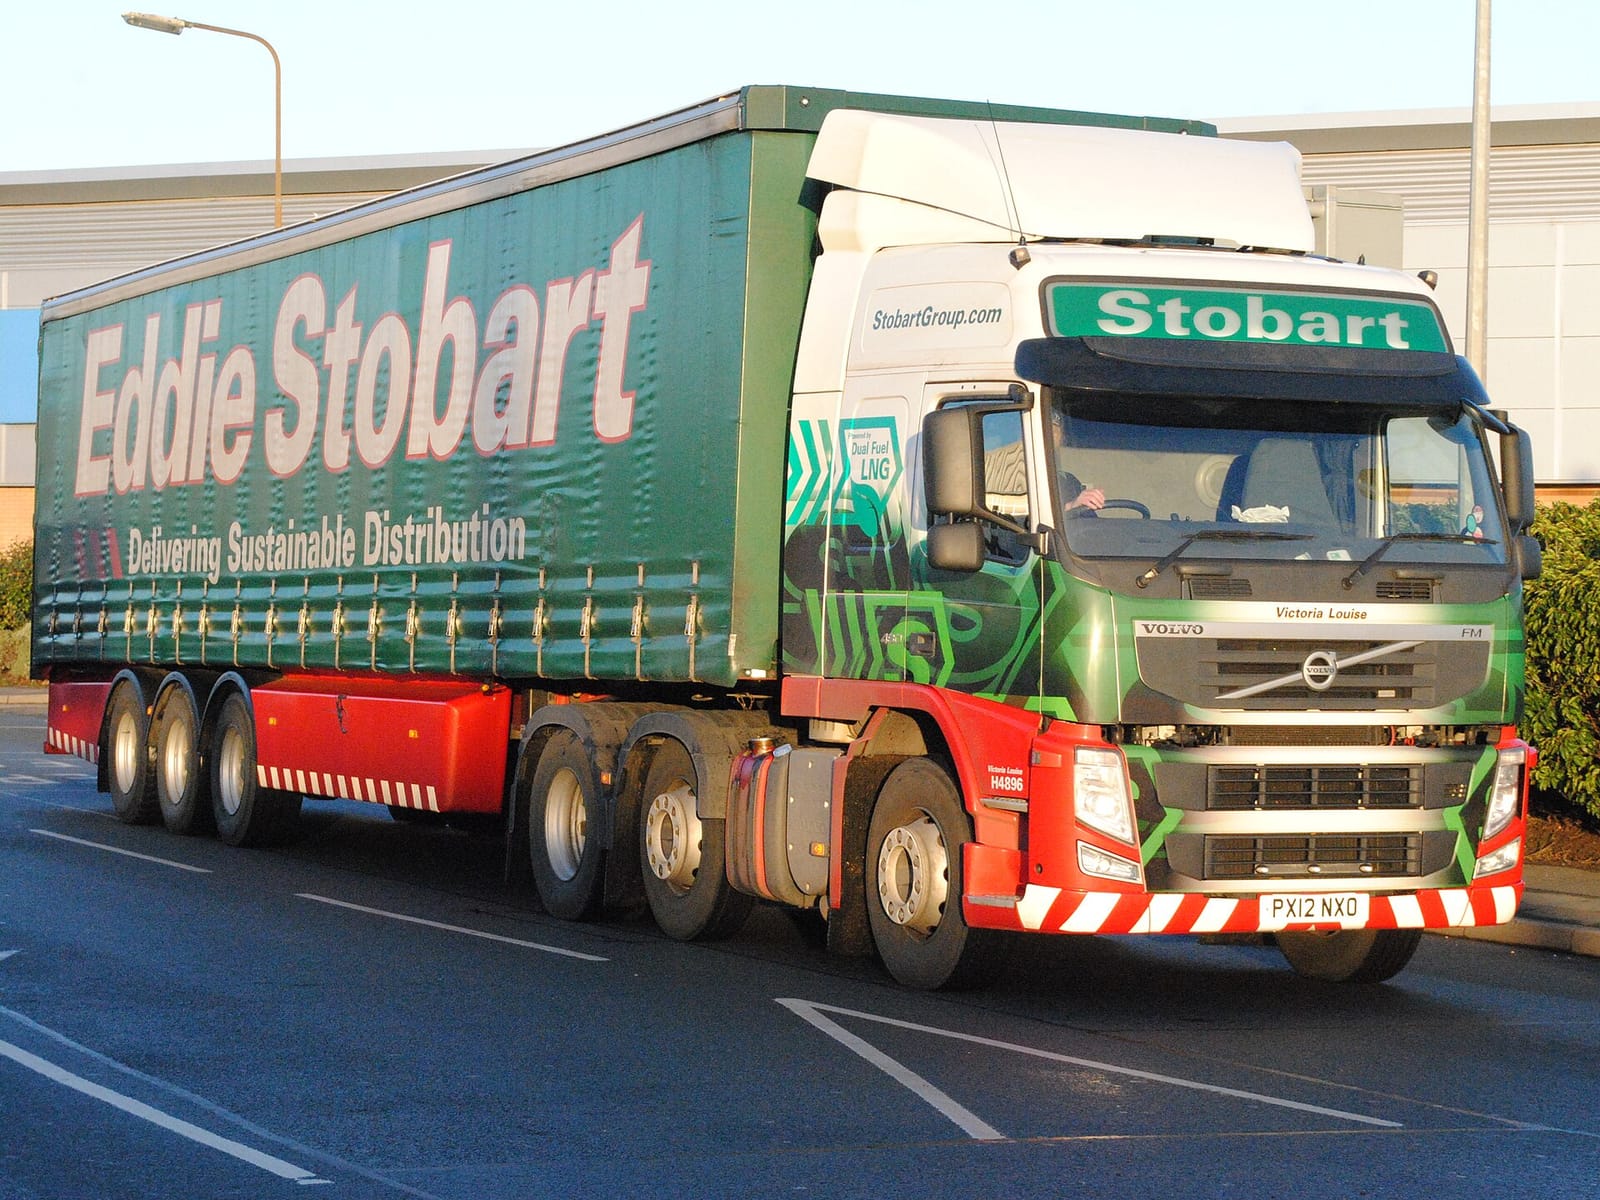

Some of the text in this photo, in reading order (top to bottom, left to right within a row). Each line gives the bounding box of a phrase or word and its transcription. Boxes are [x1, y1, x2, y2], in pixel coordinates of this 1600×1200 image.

[873, 306, 1003, 330] StobartGroup.com
[1097, 290, 1410, 350] Stobart
[74, 213, 652, 497] Eddie Stobart
[852, 440, 889, 456] Dual Fuel
[861, 457, 890, 481] LNG
[128, 503, 526, 585] Delivering Sustainable Distribution
[1275, 606, 1368, 620] Victoria Louise
[1141, 623, 1204, 636] VOLVO
[1461, 628, 1483, 639] FM
[991, 775, 1024, 792] H4896
[1272, 897, 1358, 918] PX12 NXO
